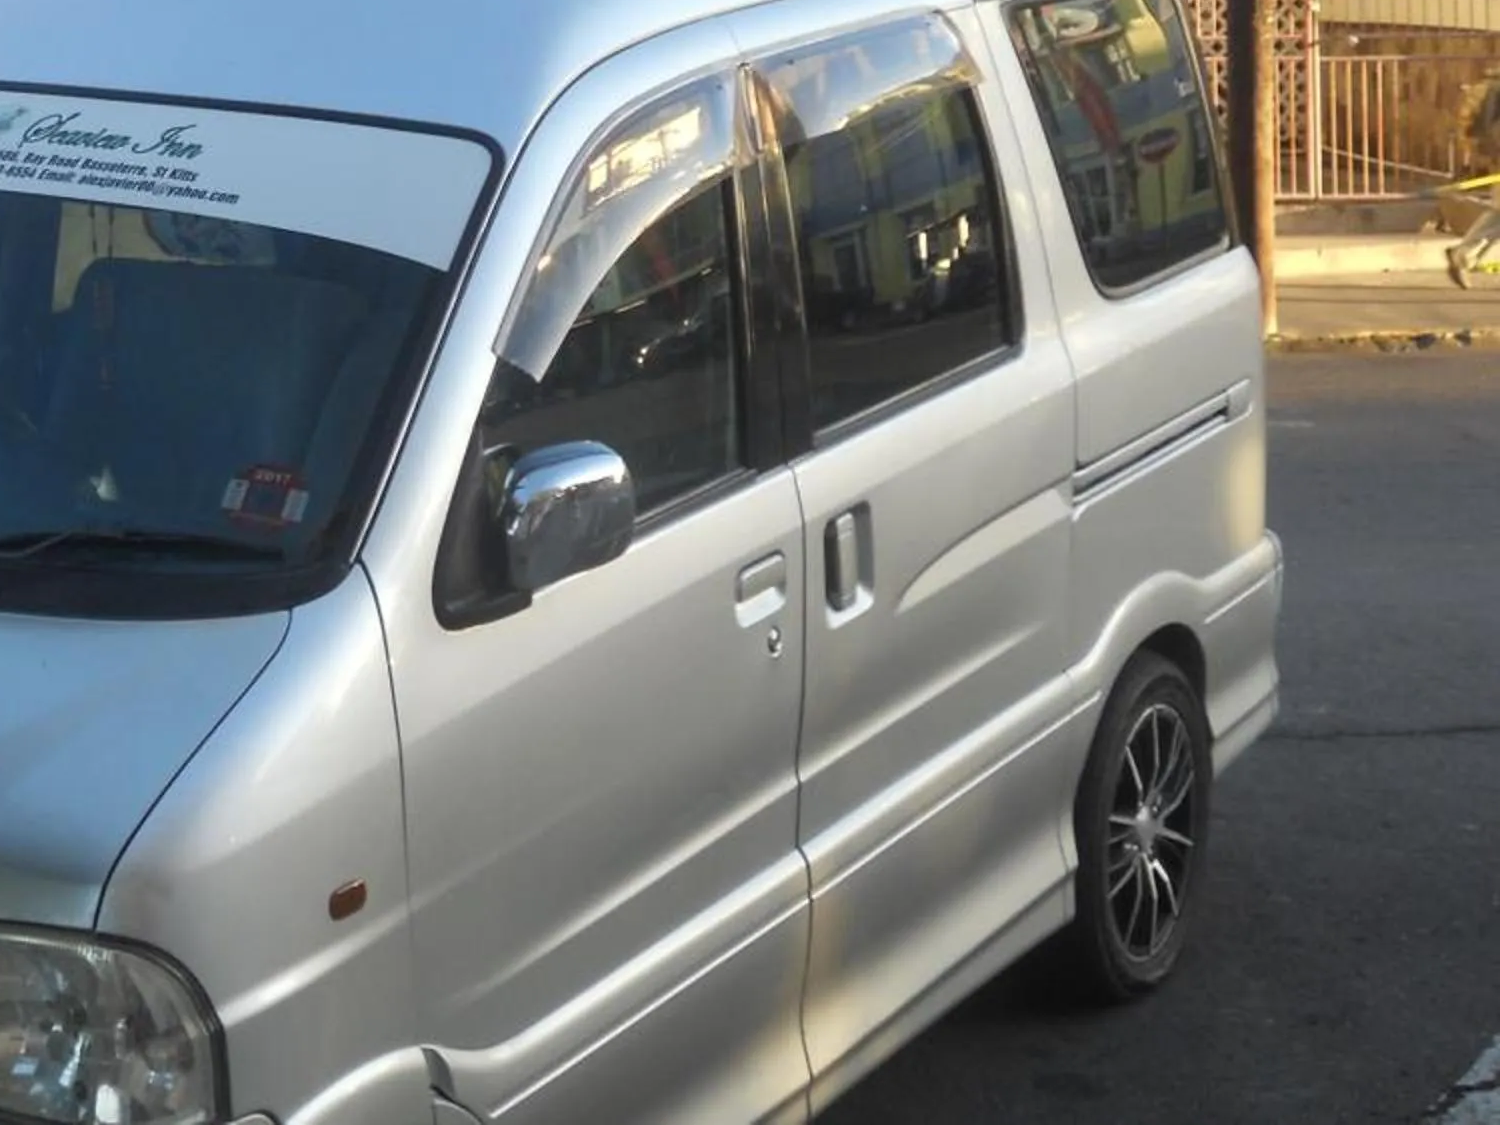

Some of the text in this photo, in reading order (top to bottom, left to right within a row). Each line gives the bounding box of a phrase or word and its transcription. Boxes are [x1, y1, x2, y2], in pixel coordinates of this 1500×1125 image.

[18, 111, 203, 160] Seaview Inn
[23, 151, 48, 166] Bay
[48, 154, 80, 168] Road
[167, 168, 199, 182] Kitts
